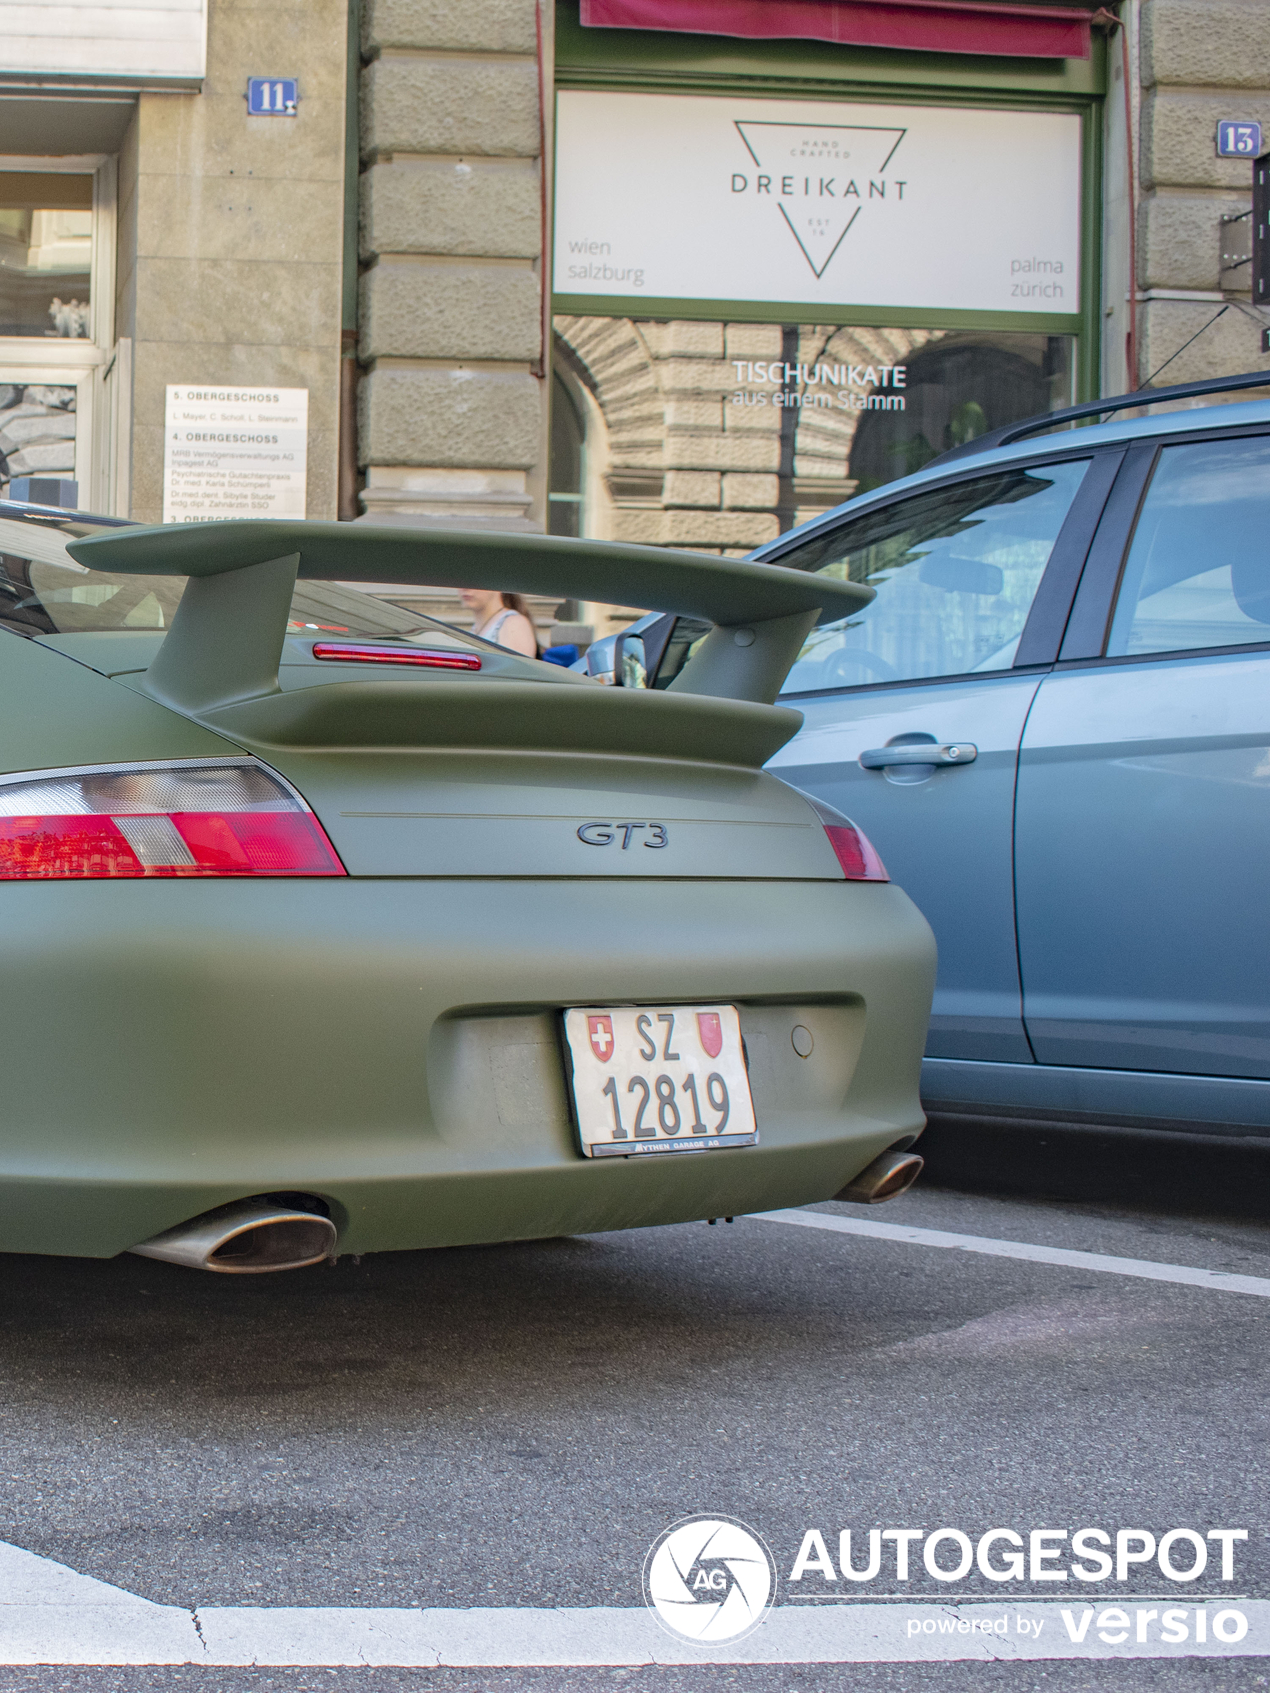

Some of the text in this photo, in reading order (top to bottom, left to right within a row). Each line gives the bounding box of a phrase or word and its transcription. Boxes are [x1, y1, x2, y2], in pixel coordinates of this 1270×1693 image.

[260, 82, 285, 111] 11
[802, 140, 839, 149] HAND
[1225, 126, 1254, 152] 13
[790, 149, 851, 159] CRAFTED
[731, 173, 907, 201] DREIKANT
[808, 218, 830, 226] EST
[568, 238, 611, 256] wien
[568, 261, 645, 287] salzburg
[1011, 256, 1064, 277] palma
[1011, 281, 1064, 298] zürich
[732, 361, 907, 388] TISCHUNIKATE
[173, 391, 279, 403] 5. OBERGESCHOSS
[732, 389, 906, 410] aus einem Stamm
[172, 432, 278, 443] 4. OBERGESCHOSS
[576, 822, 668, 850] GT3
[637, 1014, 680, 1061] SZ
[602, 1072, 730, 1139] 12819
[673, 1141, 704, 1149] GARAGE
